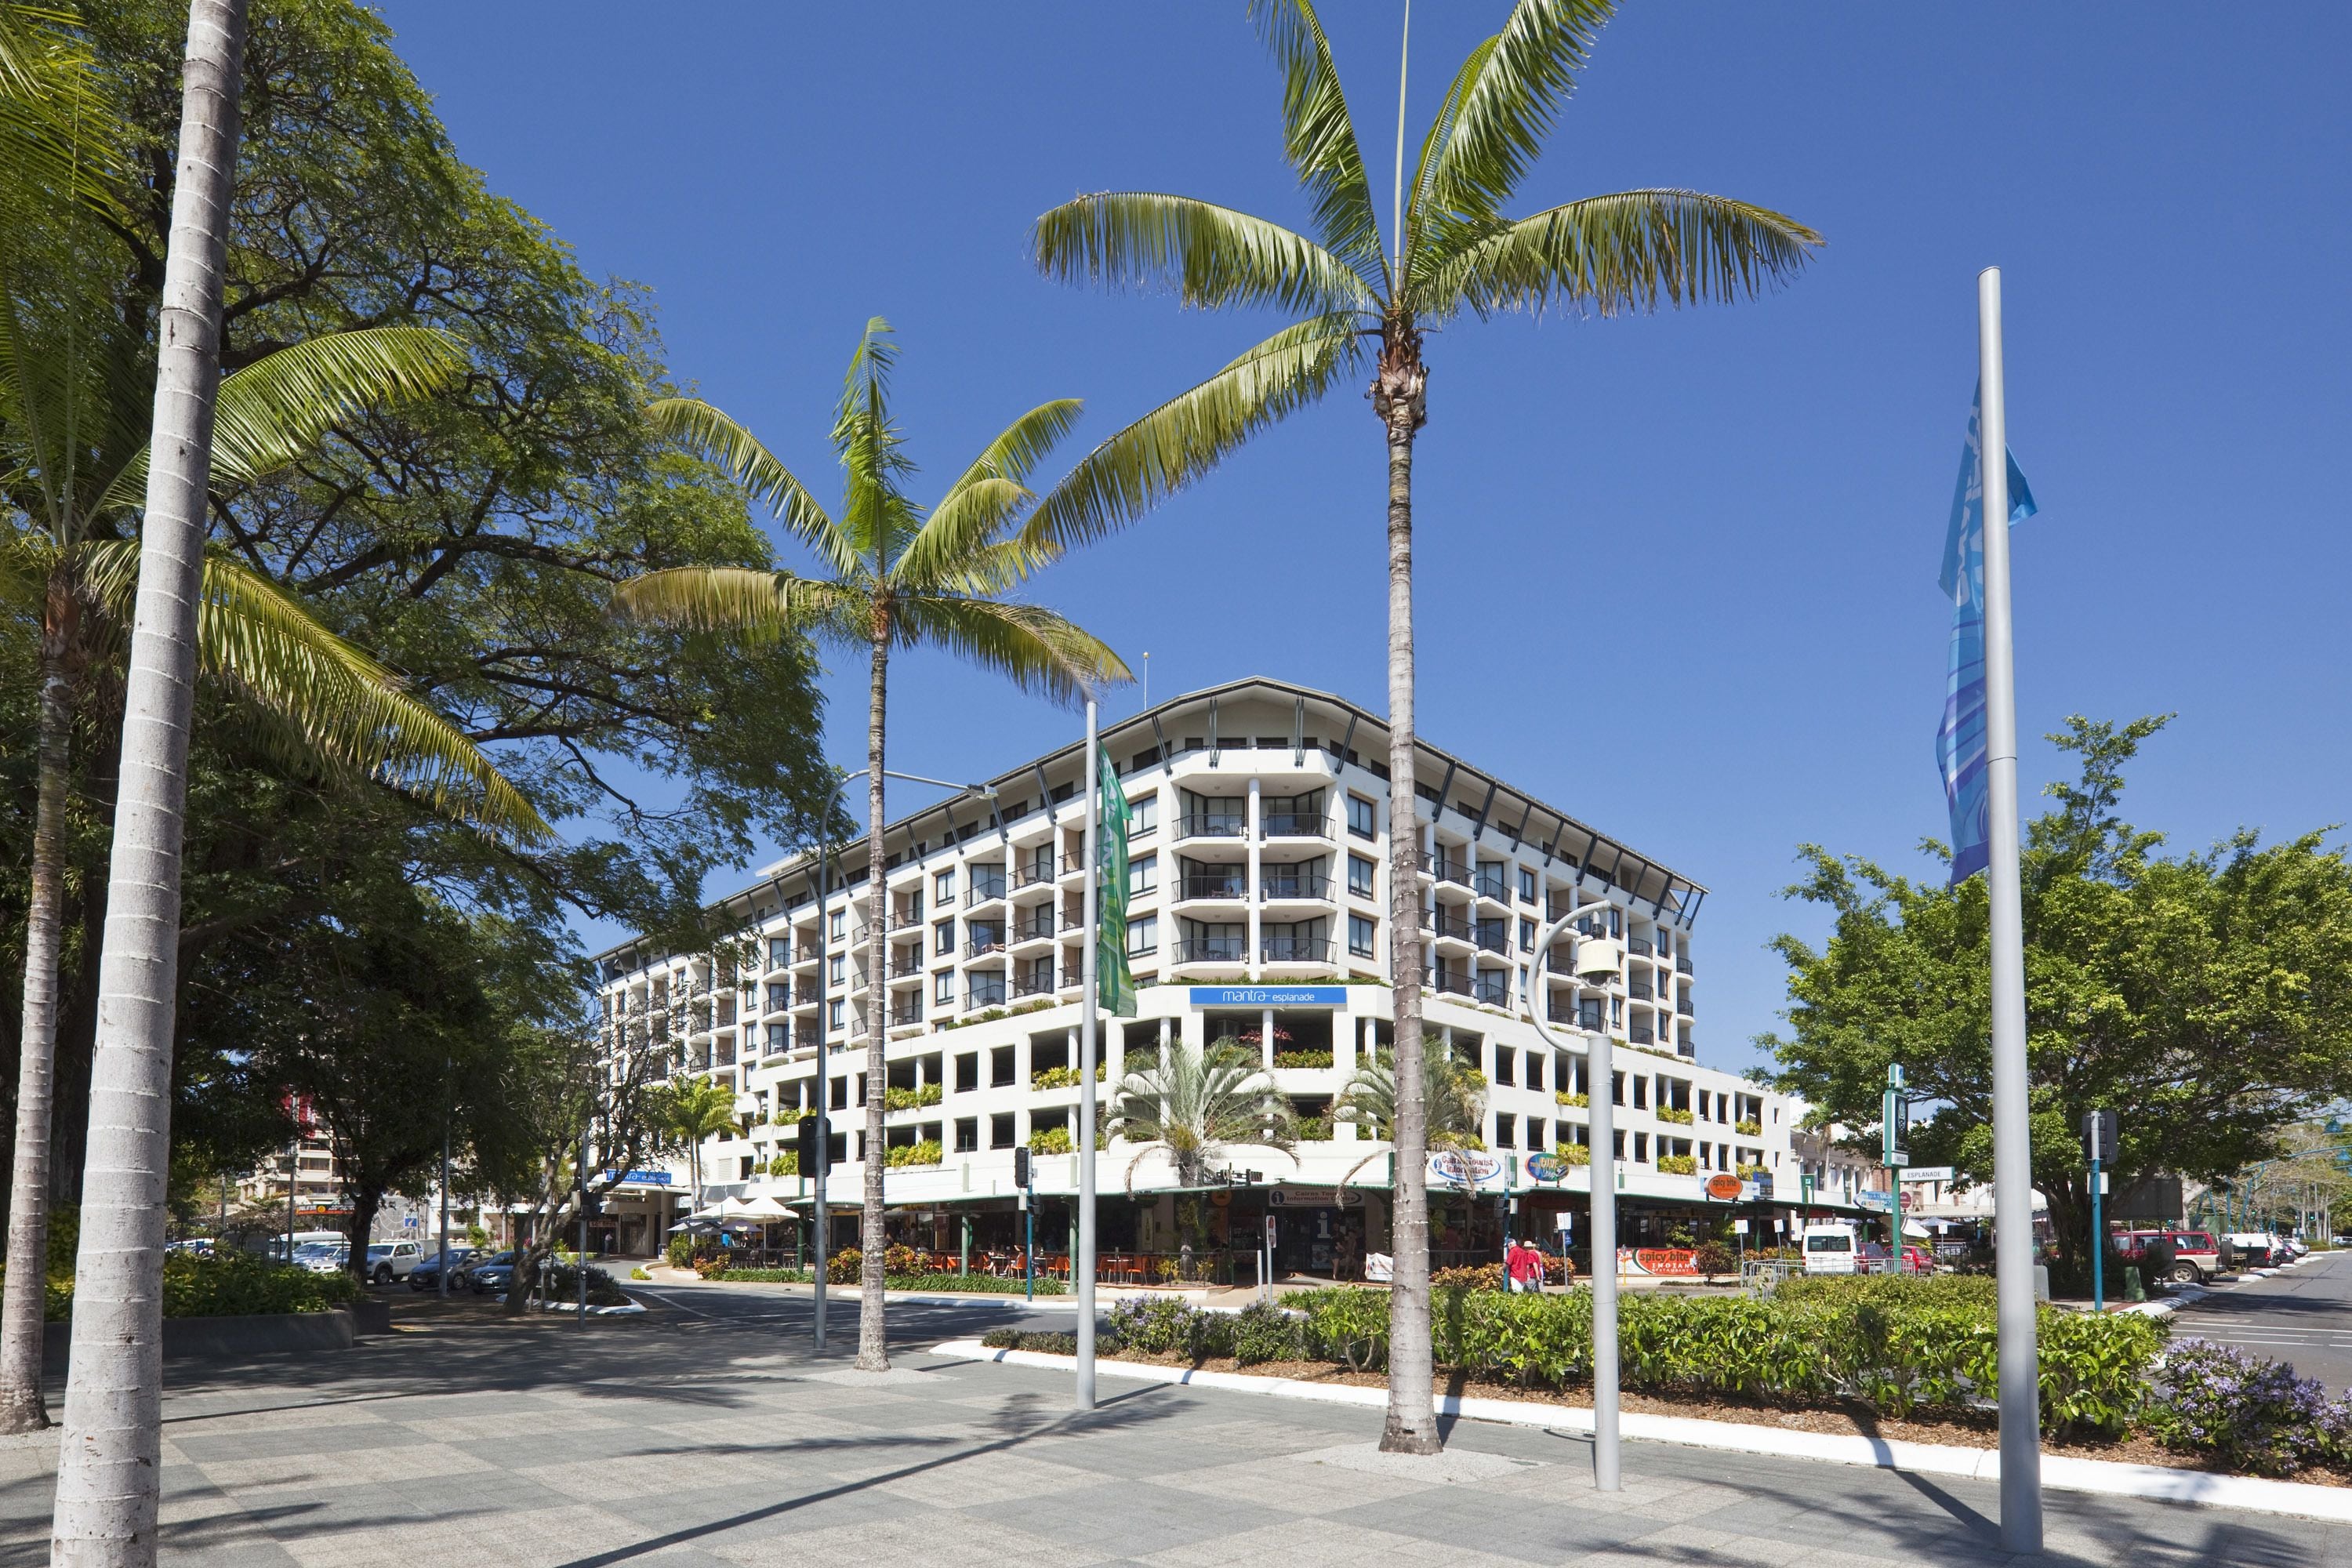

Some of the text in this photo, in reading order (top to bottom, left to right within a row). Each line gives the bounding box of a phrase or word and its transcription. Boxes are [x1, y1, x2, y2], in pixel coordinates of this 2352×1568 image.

[1222, 989, 1315, 1003] mantra esplanade
[1442, 1156, 1494, 1167] Cairn Tourist
[608, 1171, 639, 1180] mtra
[1713, 1178, 1737, 1188] spicy bite
[1639, 1252, 1666, 1263] spicy
[1669, 1251, 1689, 1261] bite
